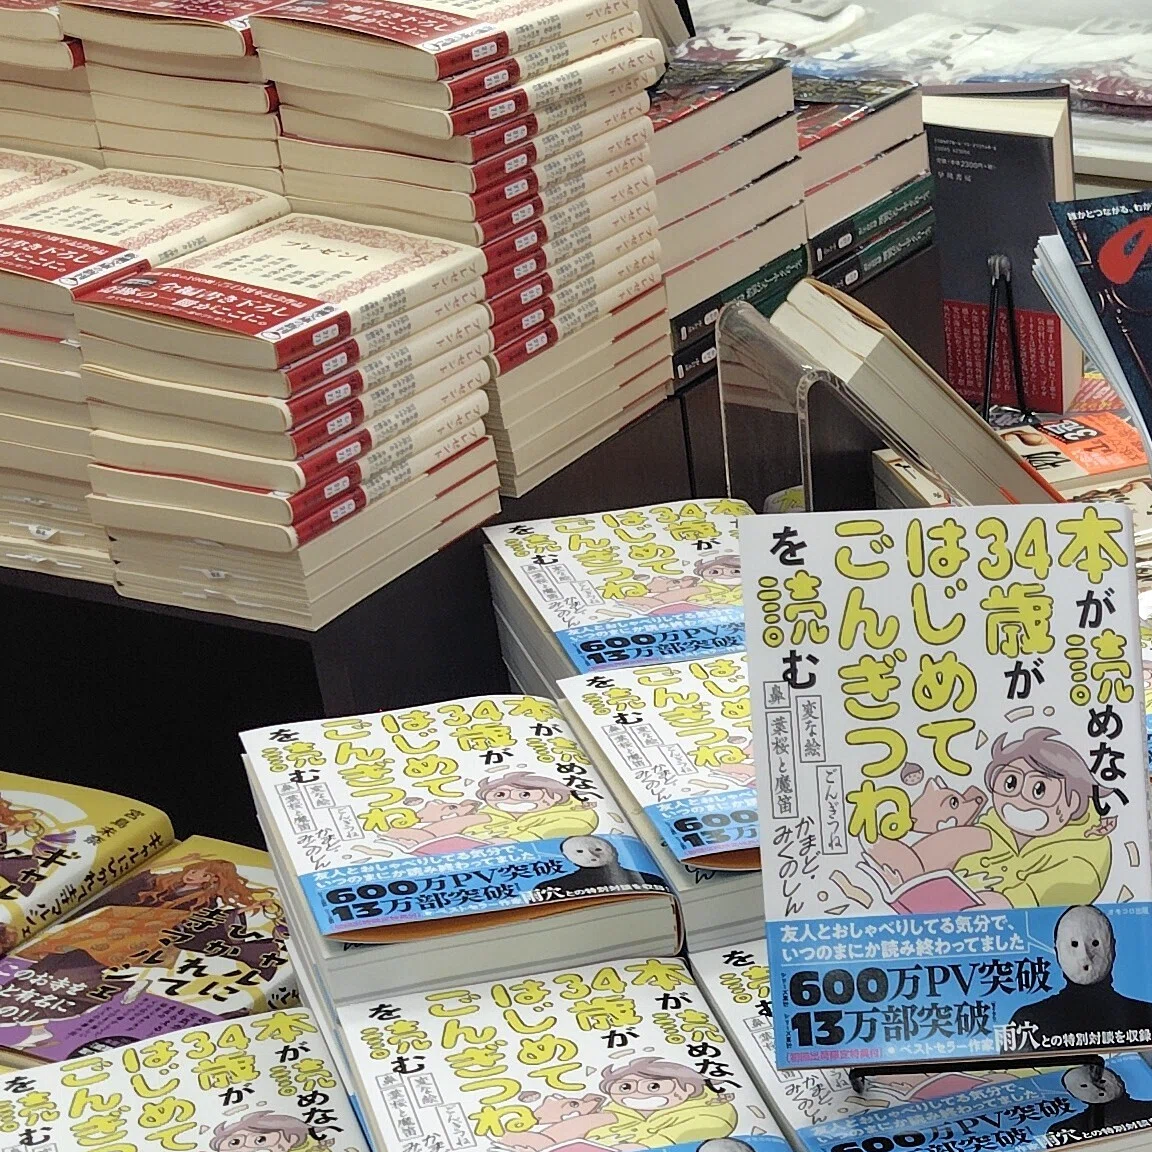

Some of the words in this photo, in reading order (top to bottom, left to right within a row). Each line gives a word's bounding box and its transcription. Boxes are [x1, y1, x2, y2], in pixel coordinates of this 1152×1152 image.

[591, 21, 637, 47] プレゼント
[94, 191, 175, 212] プレゼント
[280, 239, 371, 263] プレゼント
[430, 262, 478, 292] プレゼント
[760, 526, 827, 688] を読む
[906, 519, 975, 774] はじめて
[977, 517, 1052, 698] 34歳が
[835, 520, 912, 842] ごんぎつね
[1057, 507, 1132, 819] 本が読めない
[262, 726, 325, 783] を読む
[320, 717, 420, 833] ごんぎつね
[380, 711, 463, 799] はじめて
[437, 703, 515, 766] 34歳が
[326, 859, 566, 903] 600万PV突破
[553, 967, 640, 1049] 34歳が
[789, 957, 1054, 1007] 600万PV突破
[791, 1000, 991, 1046] 13万部突破
[183, 1025, 258, 1105] 34歳が
[362, 1001, 431, 1074] を読む
[426, 988, 539, 1139] ごんぎつね
[491, 979, 585, 1092] はじめて
[624, 959, 739, 1092] 本が読めない
[122, 1042, 196, 1151] はじめて
[251, 1013, 341, 1140] 本が読めない
